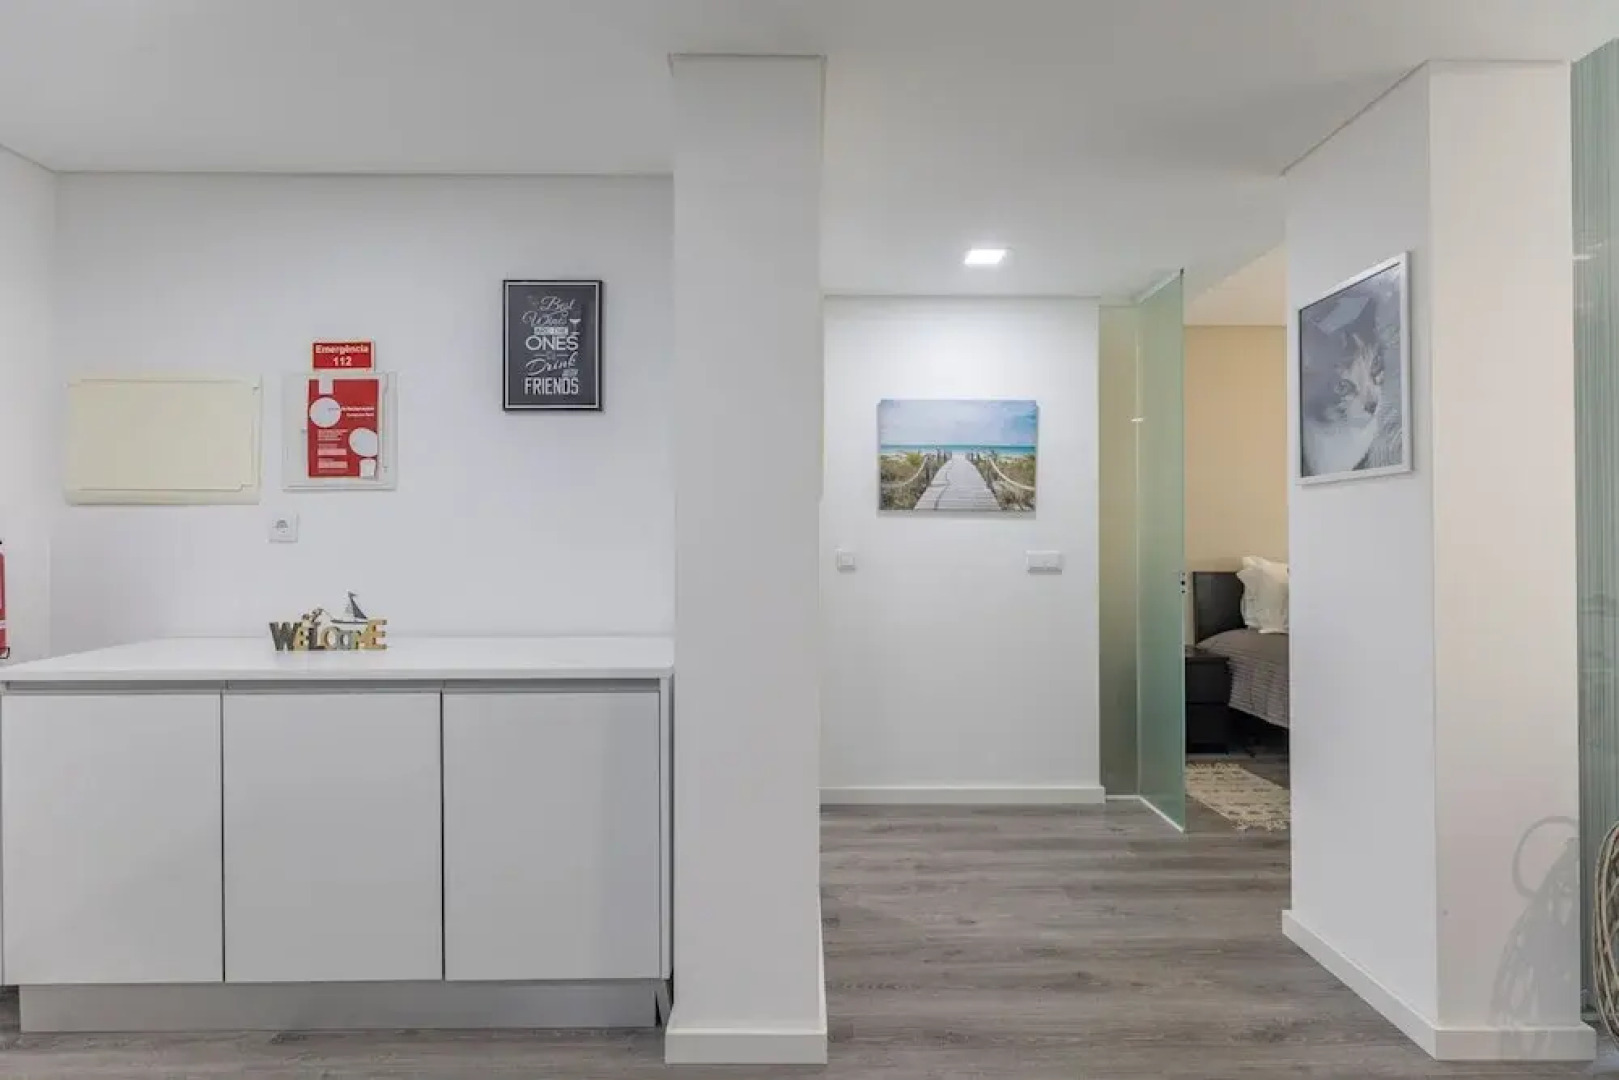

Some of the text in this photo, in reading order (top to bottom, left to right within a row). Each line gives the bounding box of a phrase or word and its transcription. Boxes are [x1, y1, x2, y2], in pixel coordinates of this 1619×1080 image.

[315, 345, 369, 355] Emergência
[525, 336, 579, 351] ONES
[333, 356, 352, 367] 112
[525, 351, 579, 376] Drink
[524, 377, 579, 395] FRIENDS
